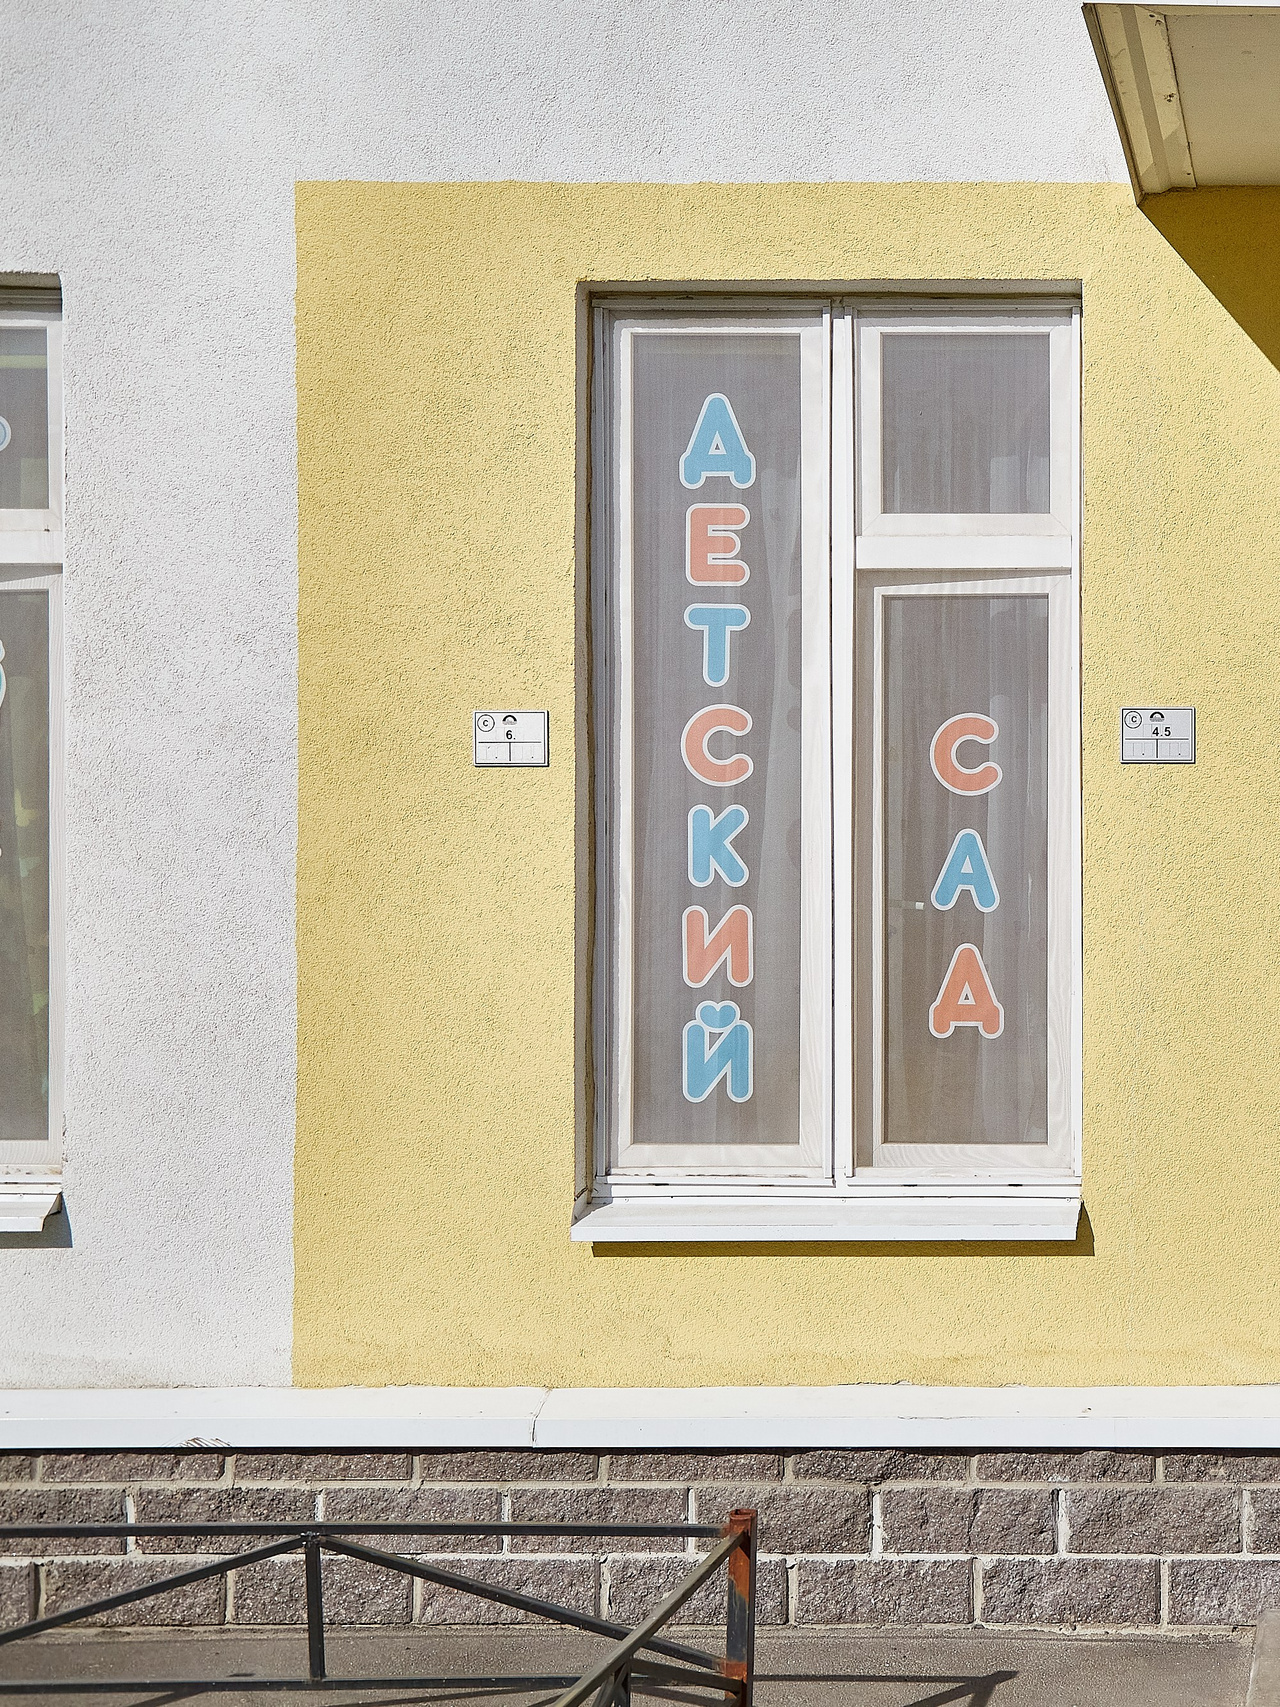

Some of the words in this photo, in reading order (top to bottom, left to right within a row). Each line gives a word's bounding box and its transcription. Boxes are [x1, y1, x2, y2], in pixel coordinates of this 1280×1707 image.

[679, 392, 757, 1103] ДЕТСКИЙ
[928, 712, 1005, 1040] САД
[1152, 726, 1172, 737] 4.5
